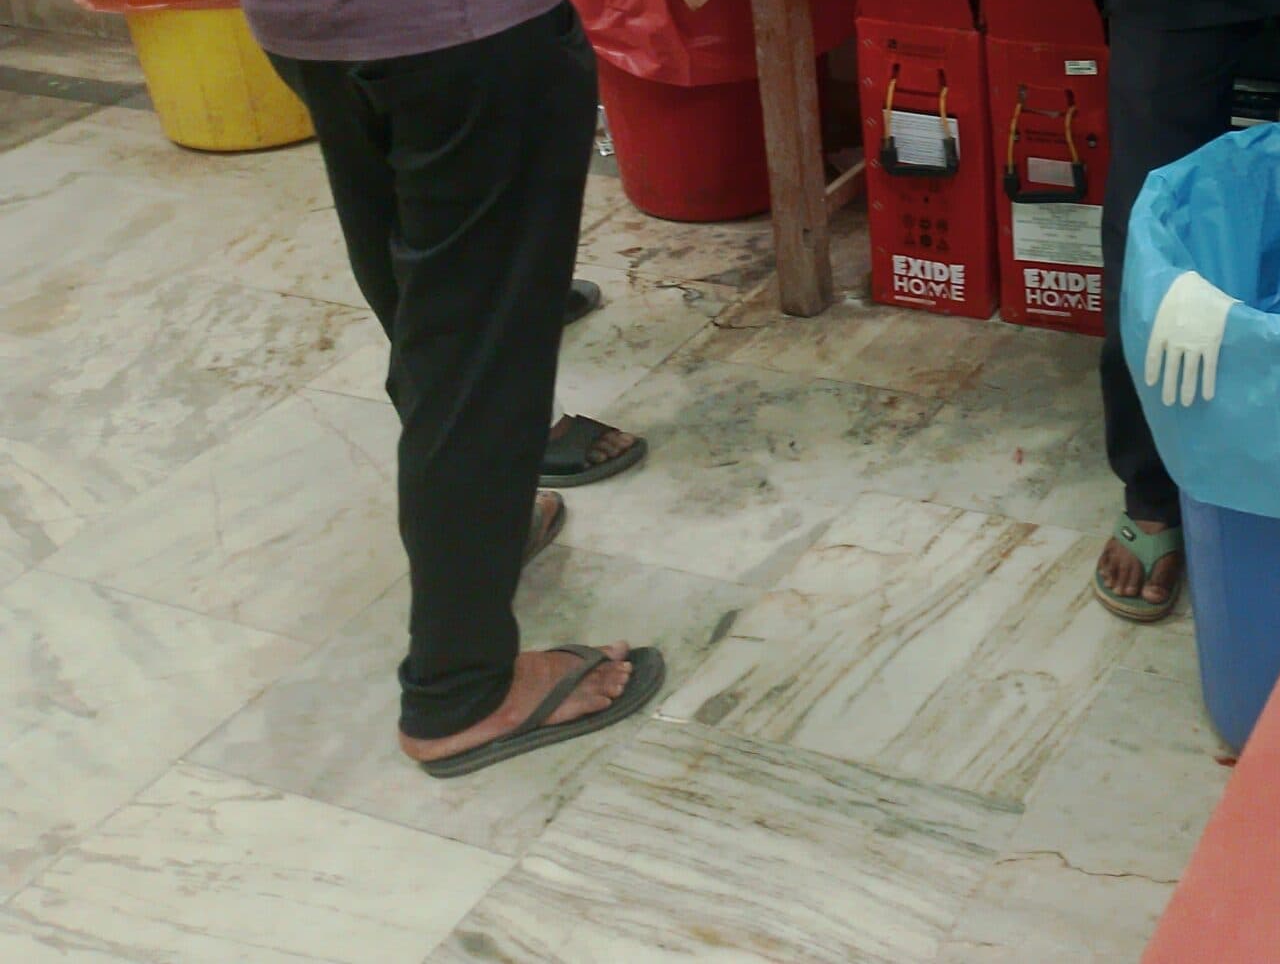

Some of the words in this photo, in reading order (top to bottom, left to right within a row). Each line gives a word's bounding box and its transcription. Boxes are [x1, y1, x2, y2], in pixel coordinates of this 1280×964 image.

[893, 254, 965, 284] EXIDE
[1023, 268, 1101, 294] EXIDE
[894, 274, 965, 302] HOME
[1025, 288, 1102, 312] HOME
